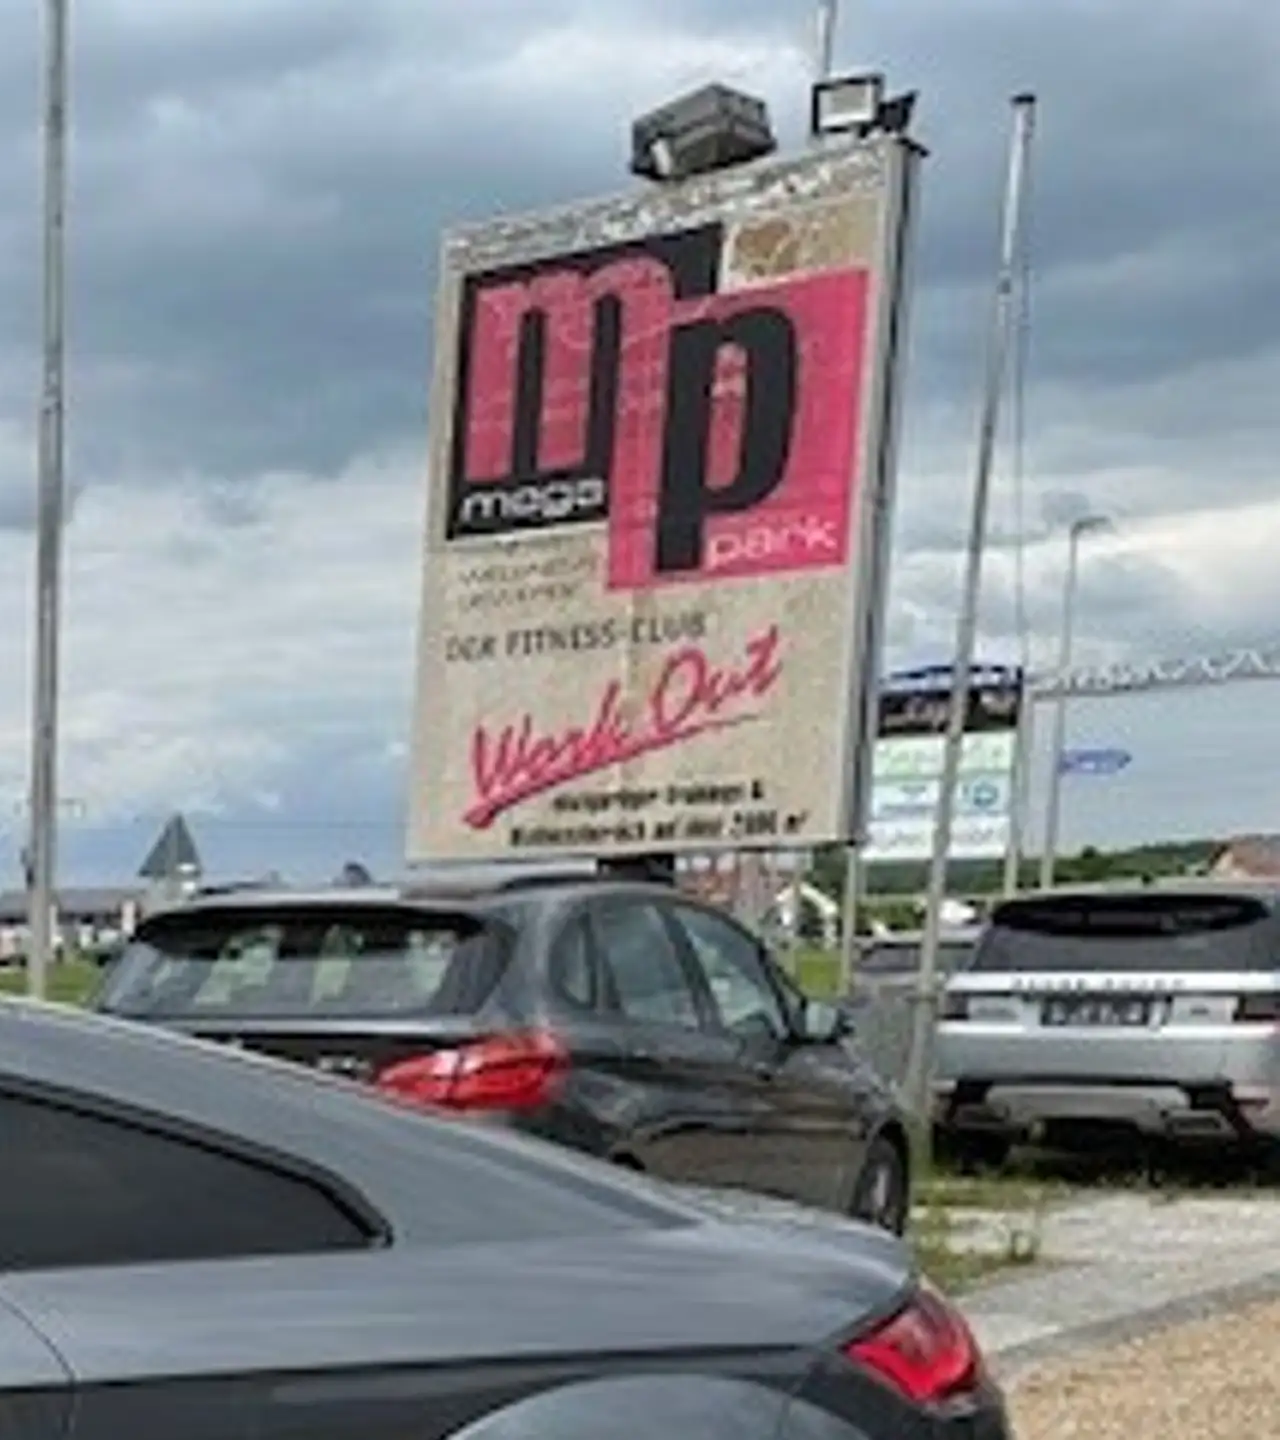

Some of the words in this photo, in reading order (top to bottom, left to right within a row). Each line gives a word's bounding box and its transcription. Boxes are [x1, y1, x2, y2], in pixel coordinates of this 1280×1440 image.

[709, 514, 839, 568] park
[470, 678, 632, 802] Work
[649, 622, 785, 734] Out
